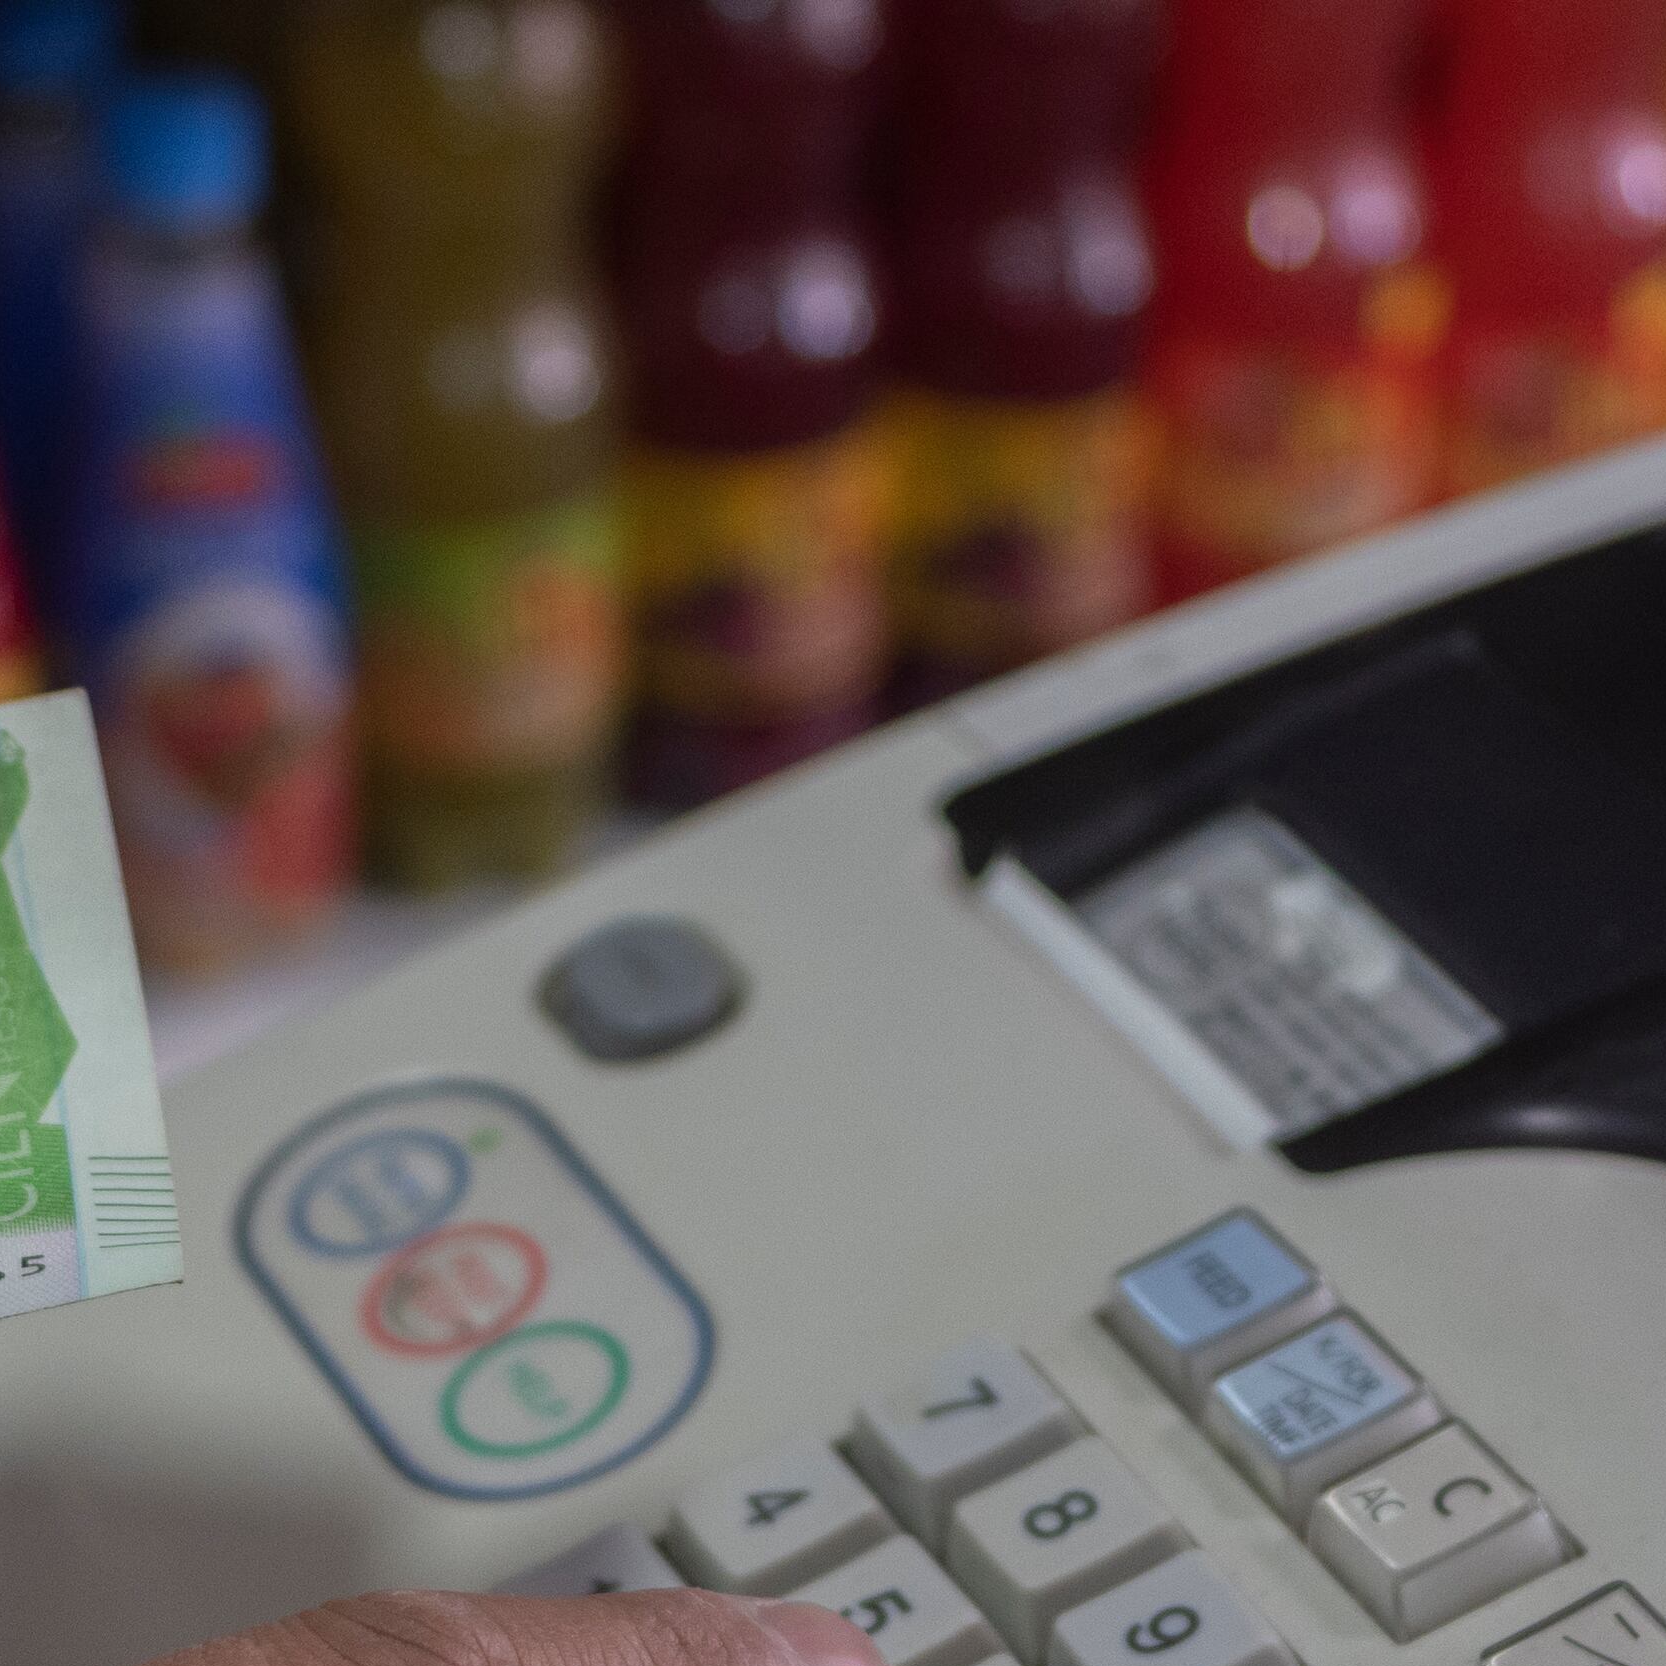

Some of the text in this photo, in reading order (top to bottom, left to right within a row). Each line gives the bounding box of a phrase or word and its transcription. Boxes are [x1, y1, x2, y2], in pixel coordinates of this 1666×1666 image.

[921, 1375, 999, 1421] 7
[744, 1487, 810, 1527] 4
[1023, 1489, 1099, 1541] 8
[1434, 1476, 1493, 1518] C
[840, 1588, 912, 1638] 5
[1125, 1605, 1201, 1655] 9
